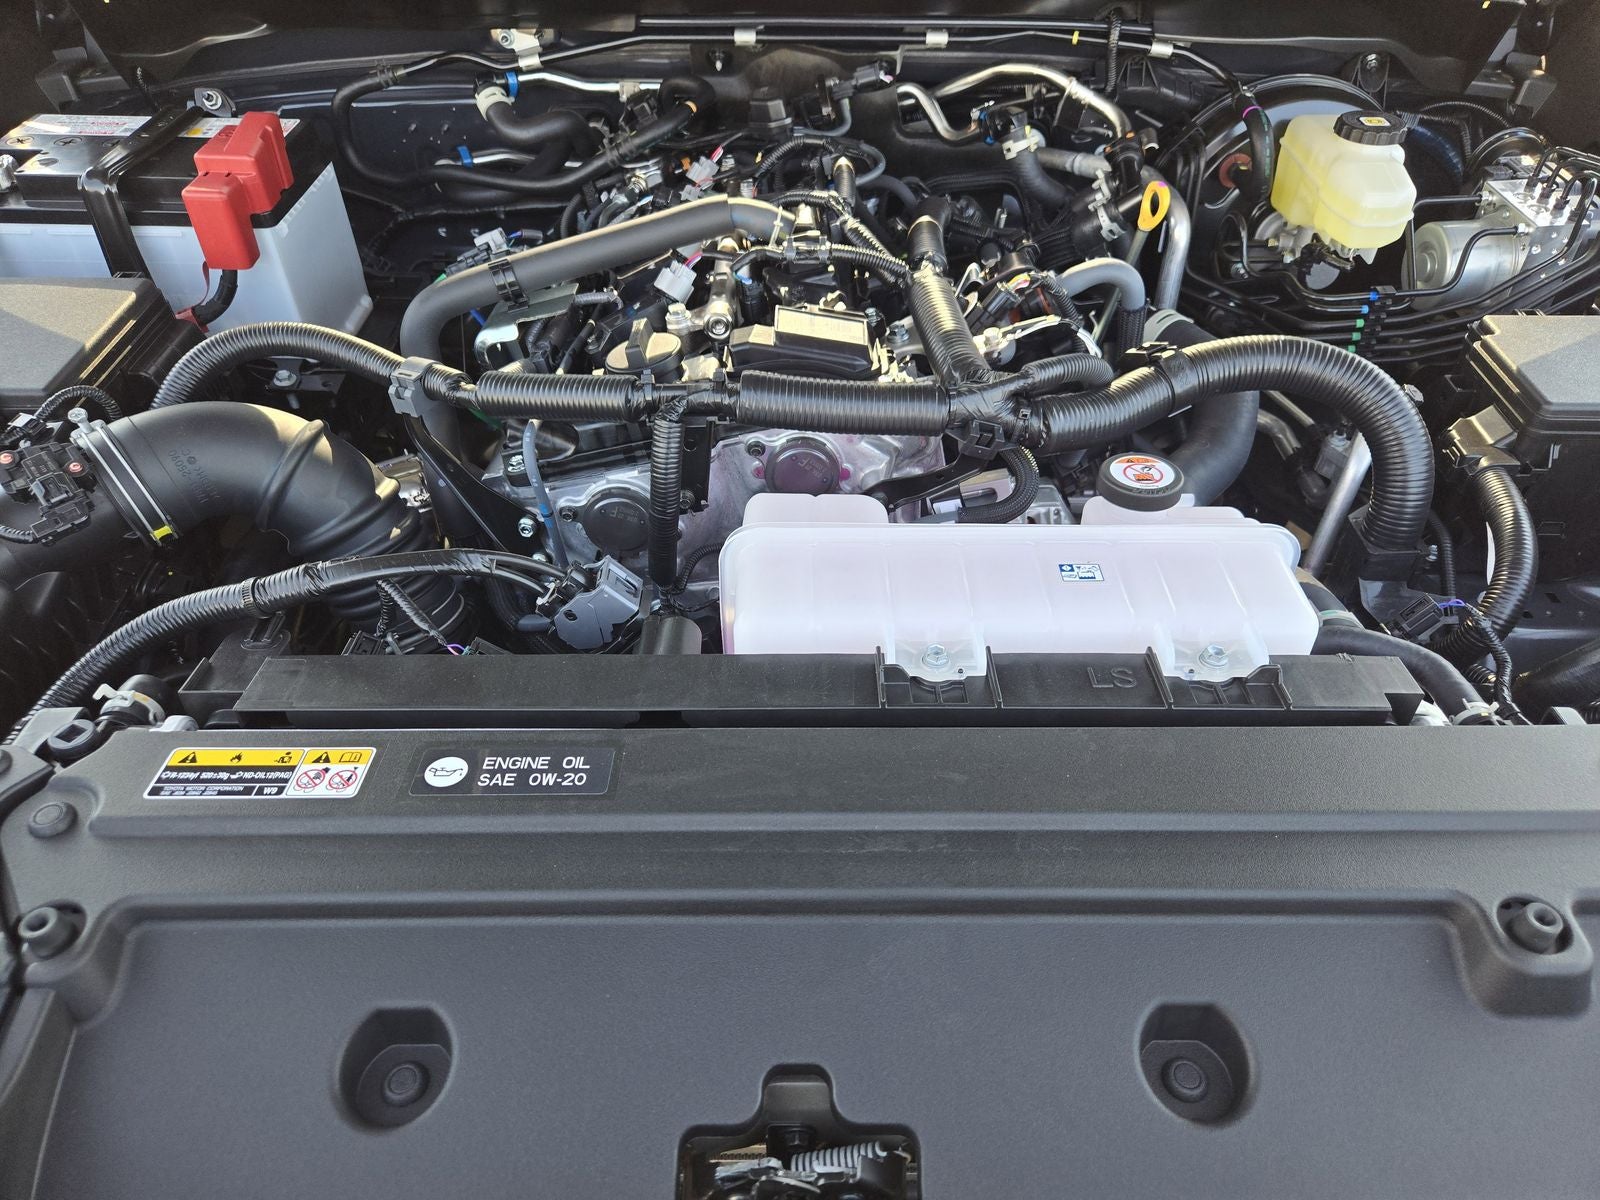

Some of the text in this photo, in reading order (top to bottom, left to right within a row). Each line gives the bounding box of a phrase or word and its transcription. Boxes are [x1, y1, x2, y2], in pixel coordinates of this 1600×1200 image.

[1087, 666, 1137, 688] LS
[482, 756, 591, 770] ENGINE OIL
[477, 773, 517, 787] SAE
[263, 786, 278, 795] W9
